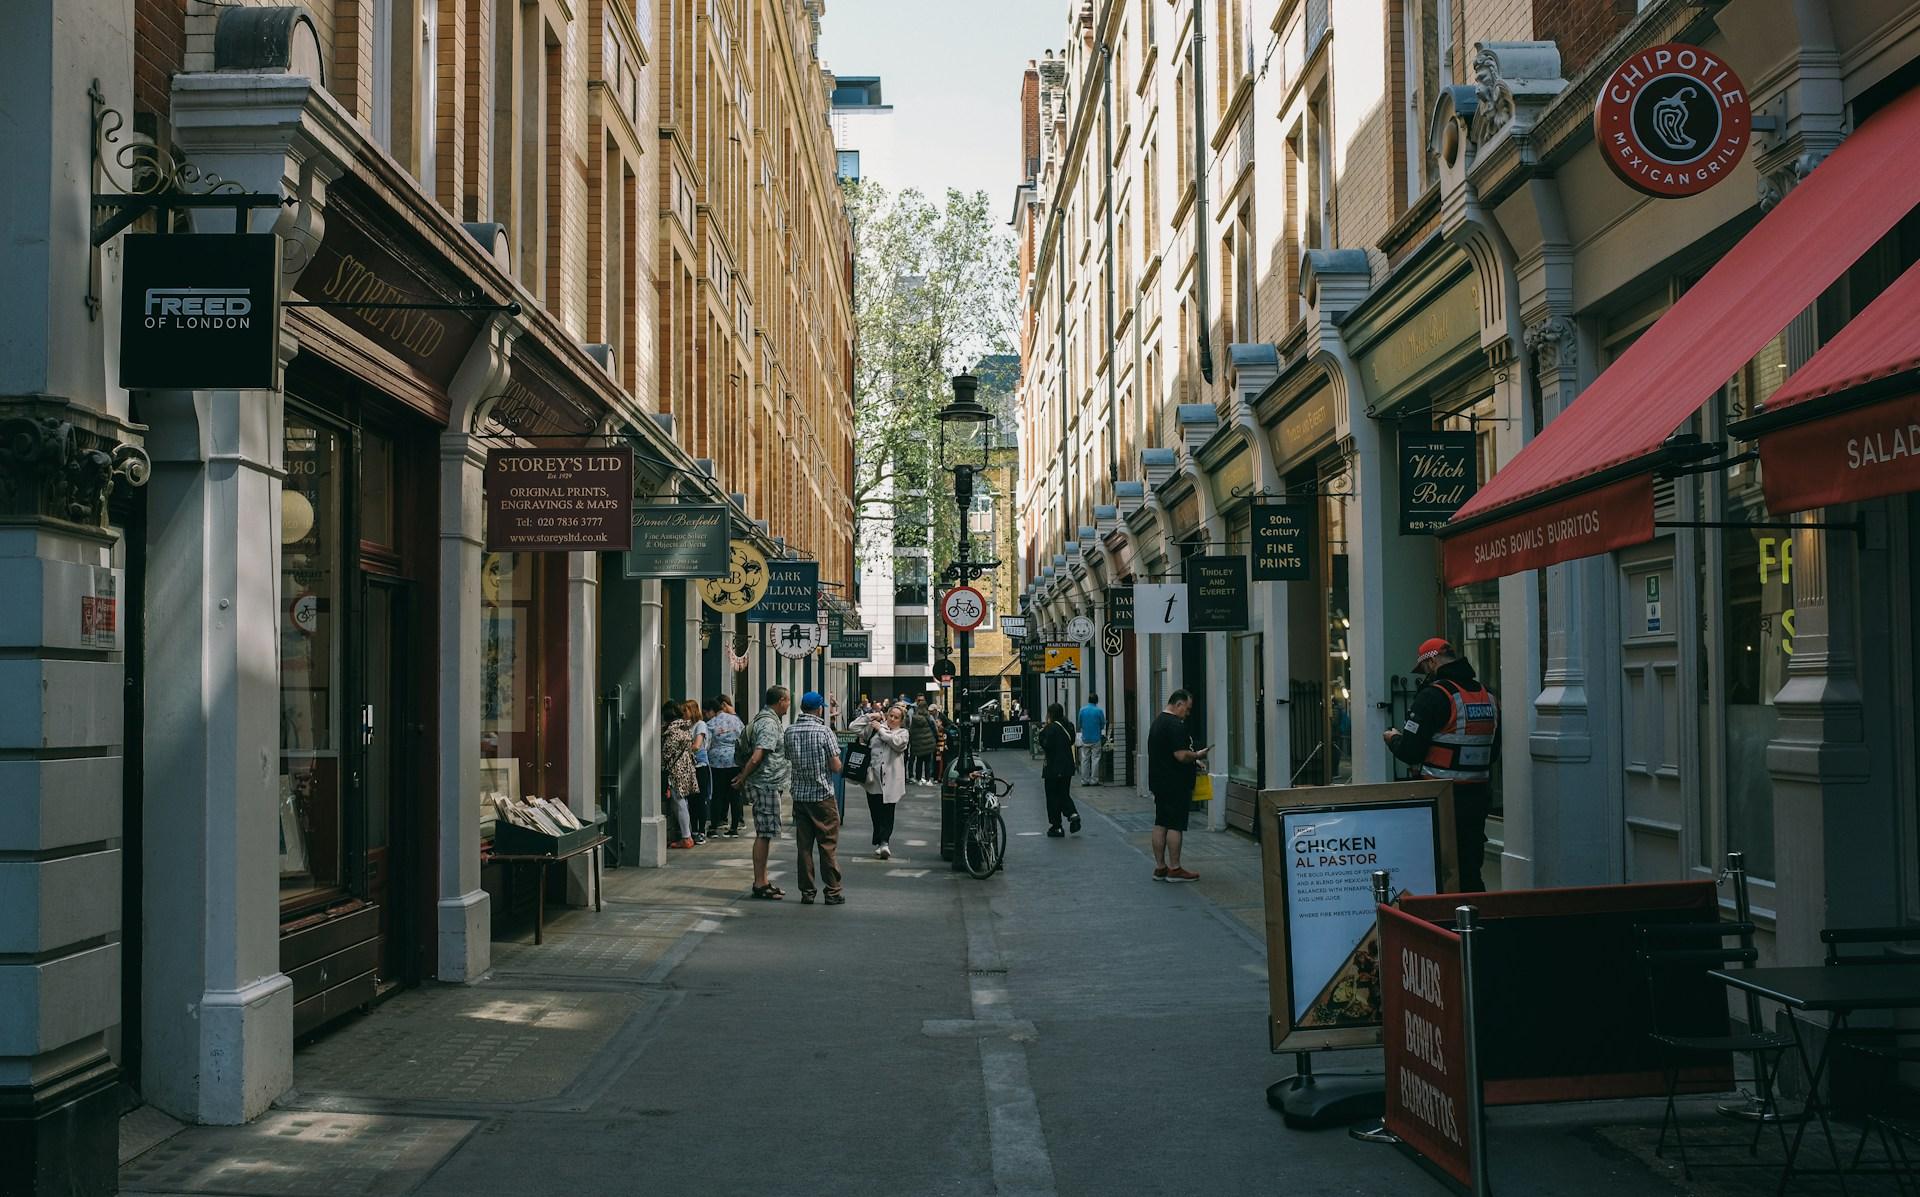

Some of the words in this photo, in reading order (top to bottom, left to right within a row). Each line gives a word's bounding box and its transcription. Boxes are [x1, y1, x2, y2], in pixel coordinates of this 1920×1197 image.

[1611, 50, 1744, 109] CHIPOTLE
[1613, 132, 1690, 184] MEXICAN
[1696, 136, 1740, 180] GRILL
[145, 288, 252, 316] FREED
[144, 317, 167, 329] OF
[176, 317, 250, 329] LONDON
[402, 312, 445, 357] LTD
[498, 457, 584, 472] STOREY'S
[587, 457, 622, 472] LTD
[1408, 454, 1465, 479] Witch
[510, 487, 565, 497] ORIGINAL
[567, 487, 609, 498] PRINTS,
[1411, 482, 1465, 504] Ball
[501, 500, 574, 510] ENGRAVINGS
[575, 500, 584, 509] &
[587, 499, 618, 510] MAPS
[516, 517, 533, 527] Tel:
[537, 517, 555, 527] 020
[557, 517, 579, 527] 7836
[581, 517, 603, 527] 3777
[632, 513, 672, 527] Daniel
[672, 512, 720, 530] Bexfield
[1269, 515, 1292, 525] 20th
[510, 532, 608, 544] www.storeysltd.co.uk
[1259, 527, 1300, 537] Century
[1474, 539, 1508, 564] SALADS
[1510, 527, 1544, 554] BOWLS
[1547, 510, 1600, 543] BURRITOS
[1266, 543, 1294, 554] FINE
[1259, 557, 1301, 569] PRINTS
[768, 571, 801, 581] MARK
[1200, 567, 1233, 576] TINDLEY
[1209, 578, 1226, 586] AND
[1200, 586, 1236, 596] EVERETT
[754, 602, 811, 613] ANTIQUES
[1164, 593, 1178, 623] t
[962, 687, 969, 696] 2
[1295, 836, 1377, 854] CHICKEN
[1296, 857, 1314, 868] AL
[1319, 853, 1377, 866] PASTOR
